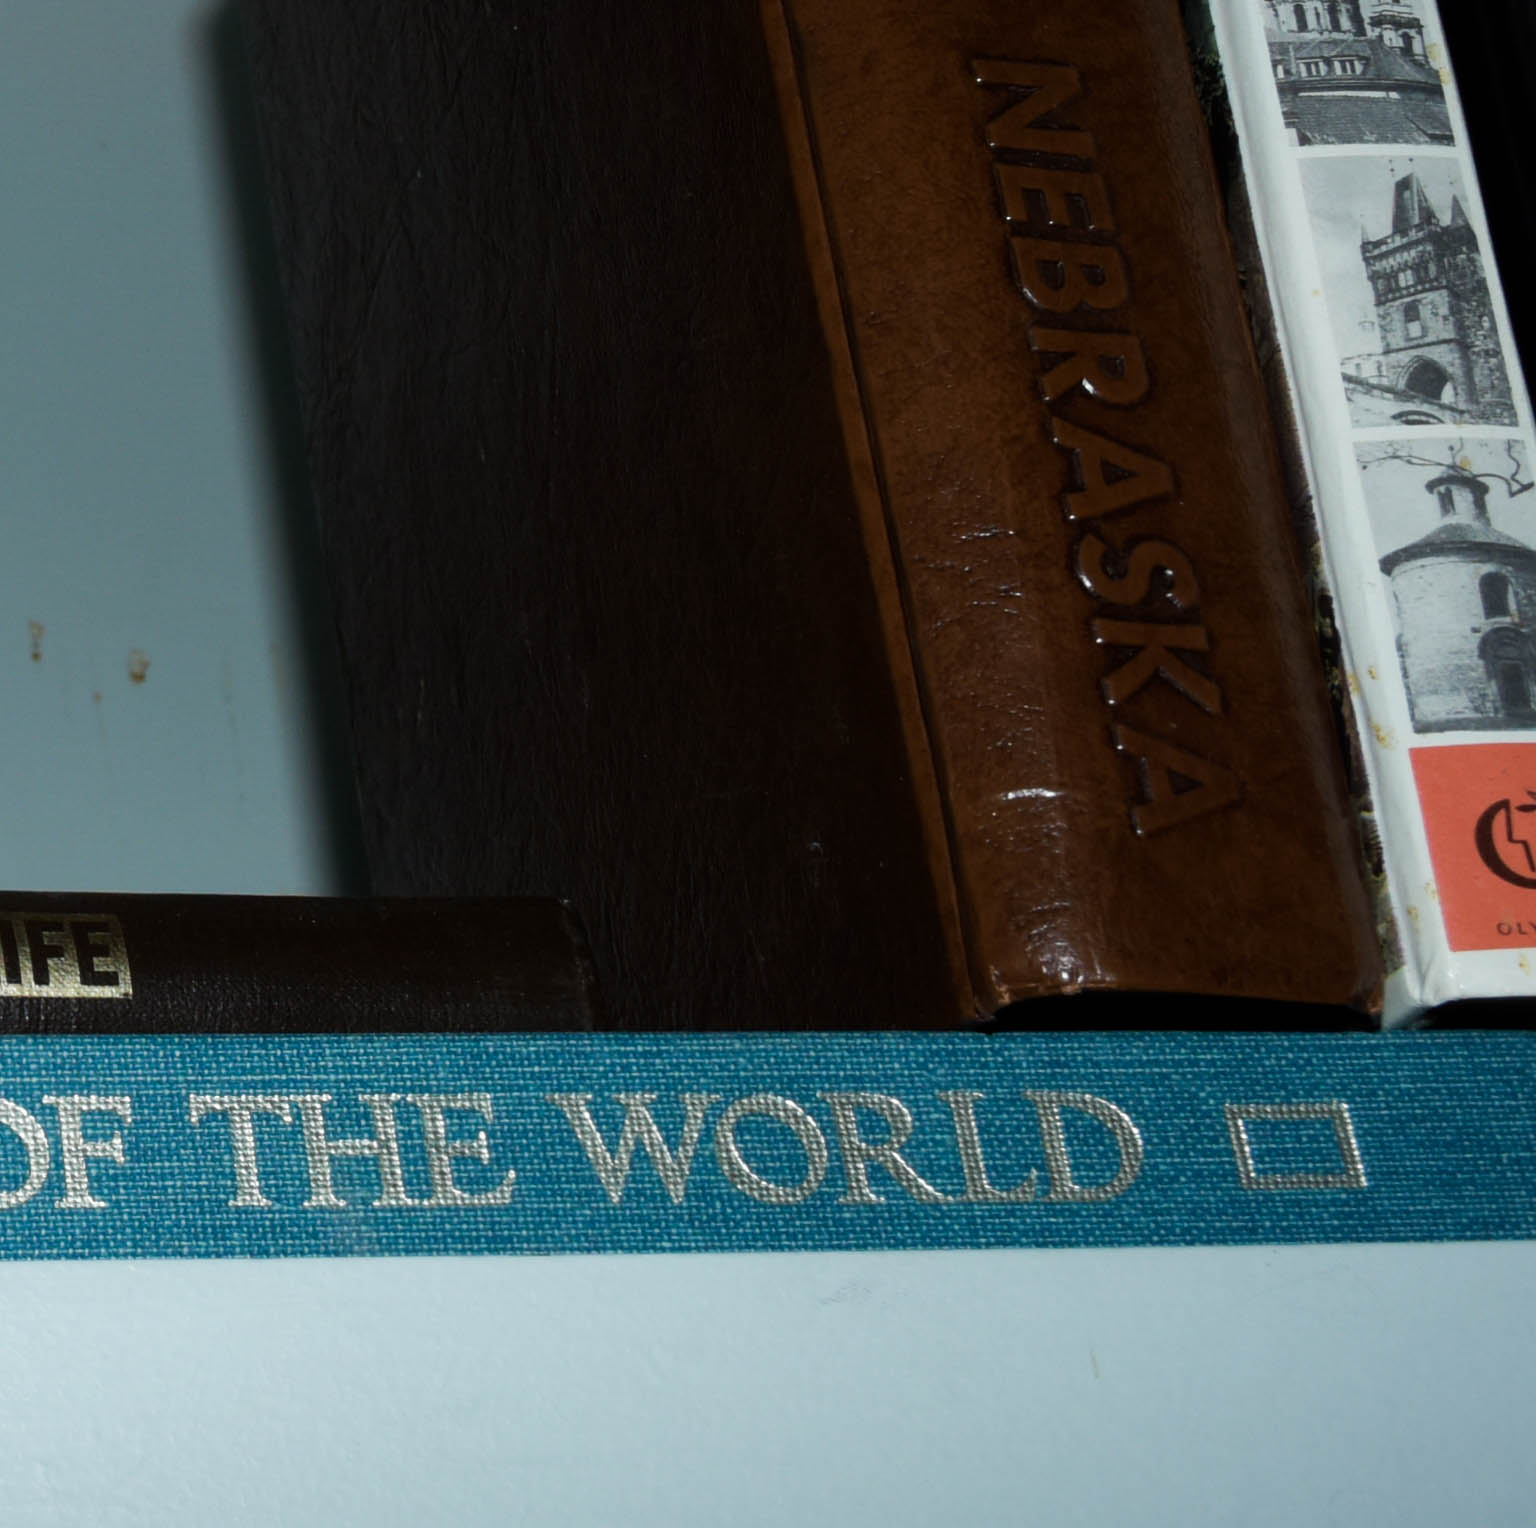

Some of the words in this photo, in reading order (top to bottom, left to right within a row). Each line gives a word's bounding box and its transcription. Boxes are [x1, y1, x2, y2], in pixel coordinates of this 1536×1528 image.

[971, 55, 1241, 840] NEBRASKA
[188, 1091, 517, 1209] THE
[545, 1088, 1145, 1206] WORLD
